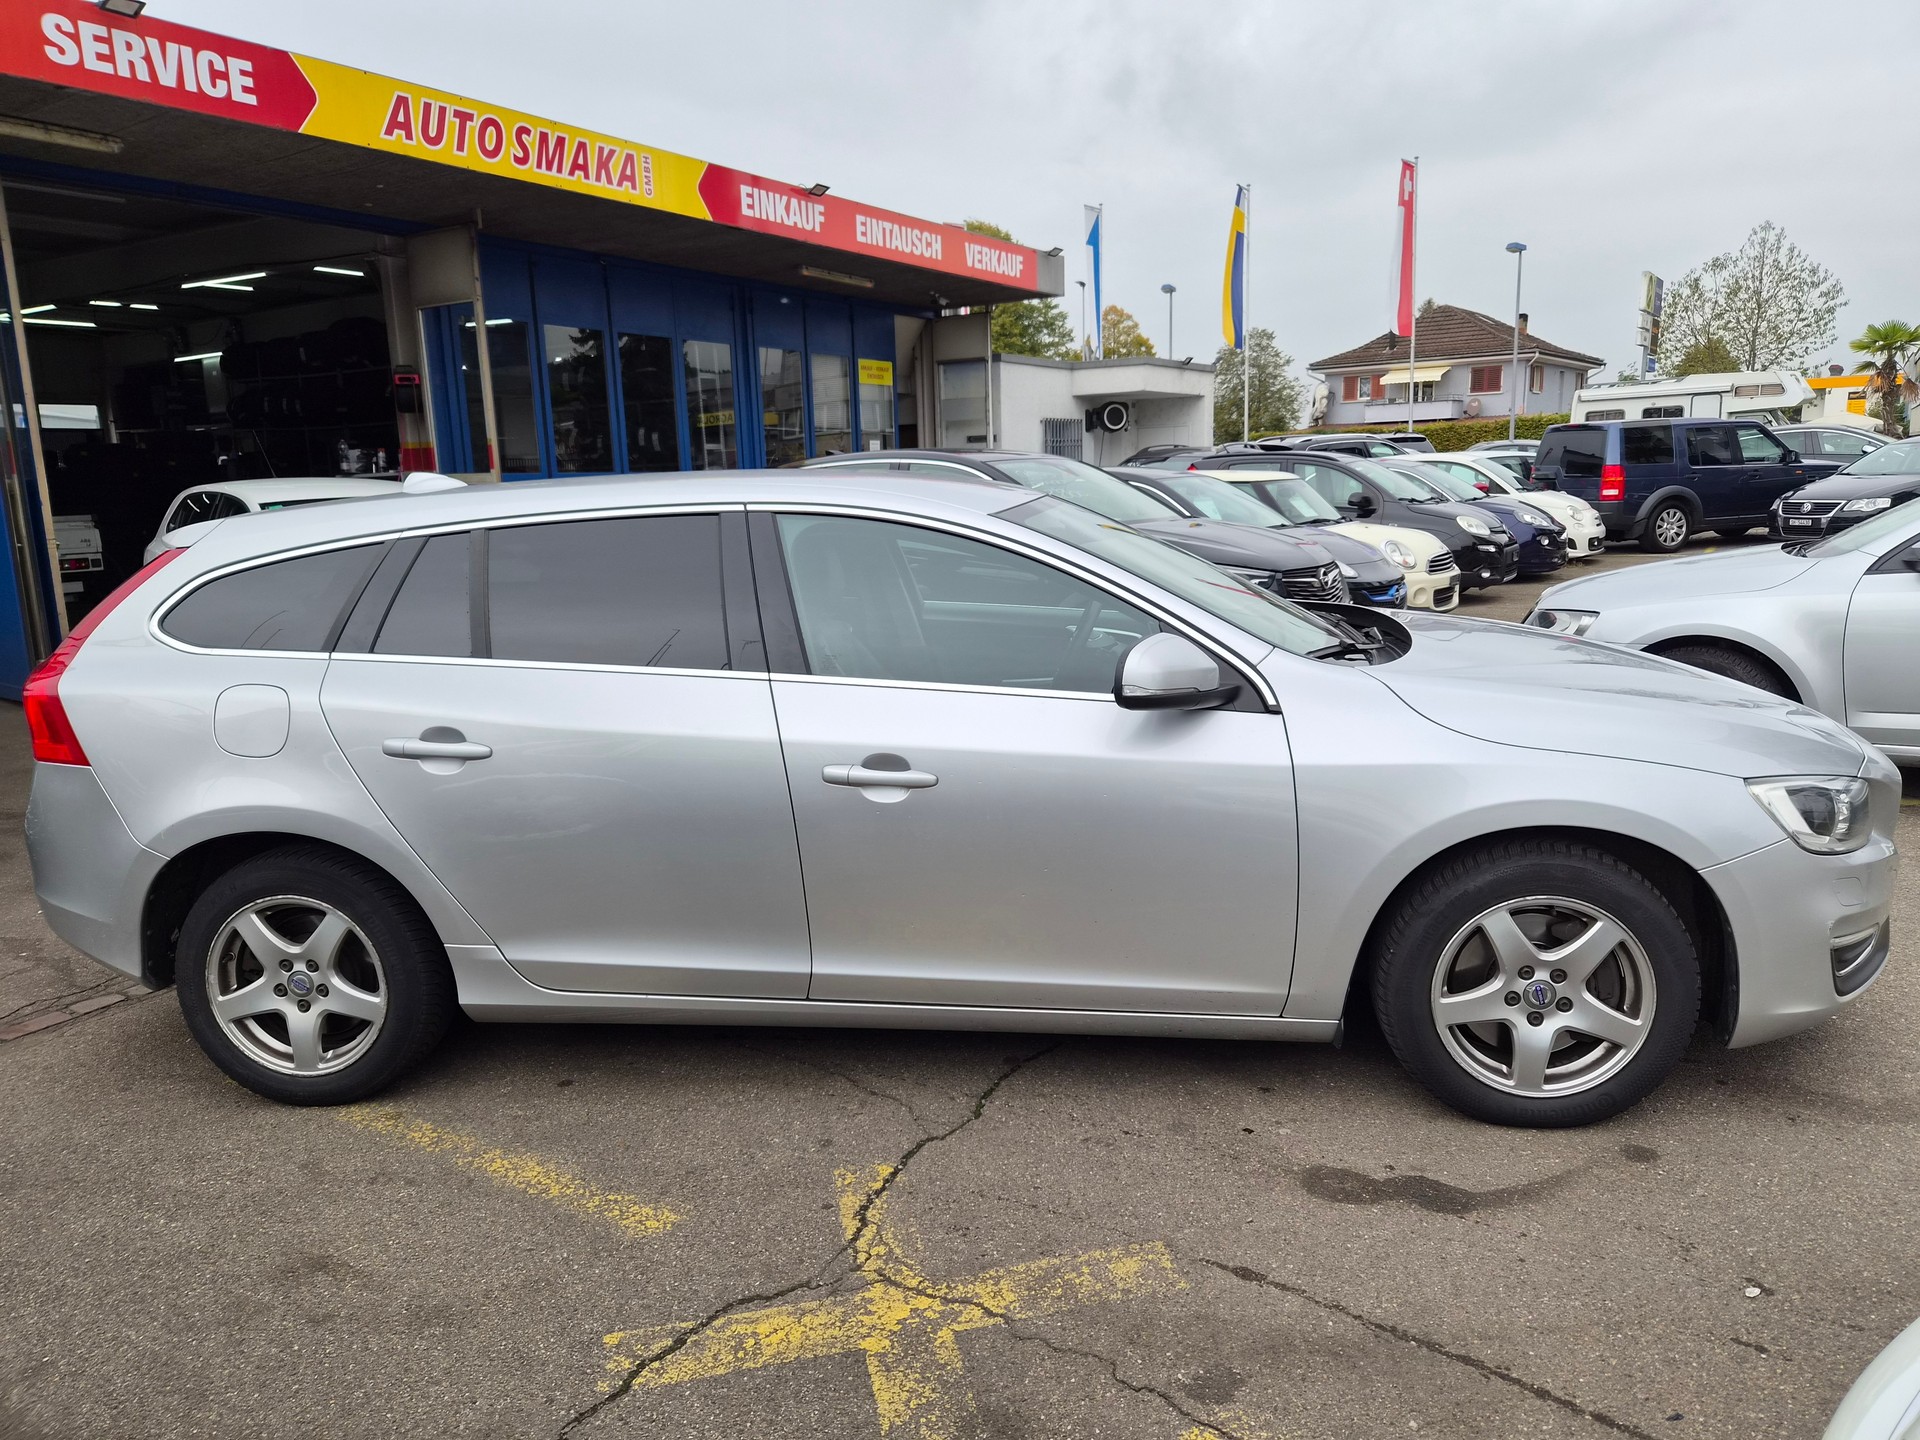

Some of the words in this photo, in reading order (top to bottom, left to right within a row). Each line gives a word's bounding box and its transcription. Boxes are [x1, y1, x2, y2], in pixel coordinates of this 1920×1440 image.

[40, 12, 257, 106] SERVICE
[382, 92, 504, 162] AUTO
[511, 124, 638, 193] SMAKA
[643, 155, 653, 197] GMBH
[740, 184, 825, 232] EINKAUF
[855, 215, 942, 260] EINTAUSCH
[964, 242, 1024, 278] VERKAUF
